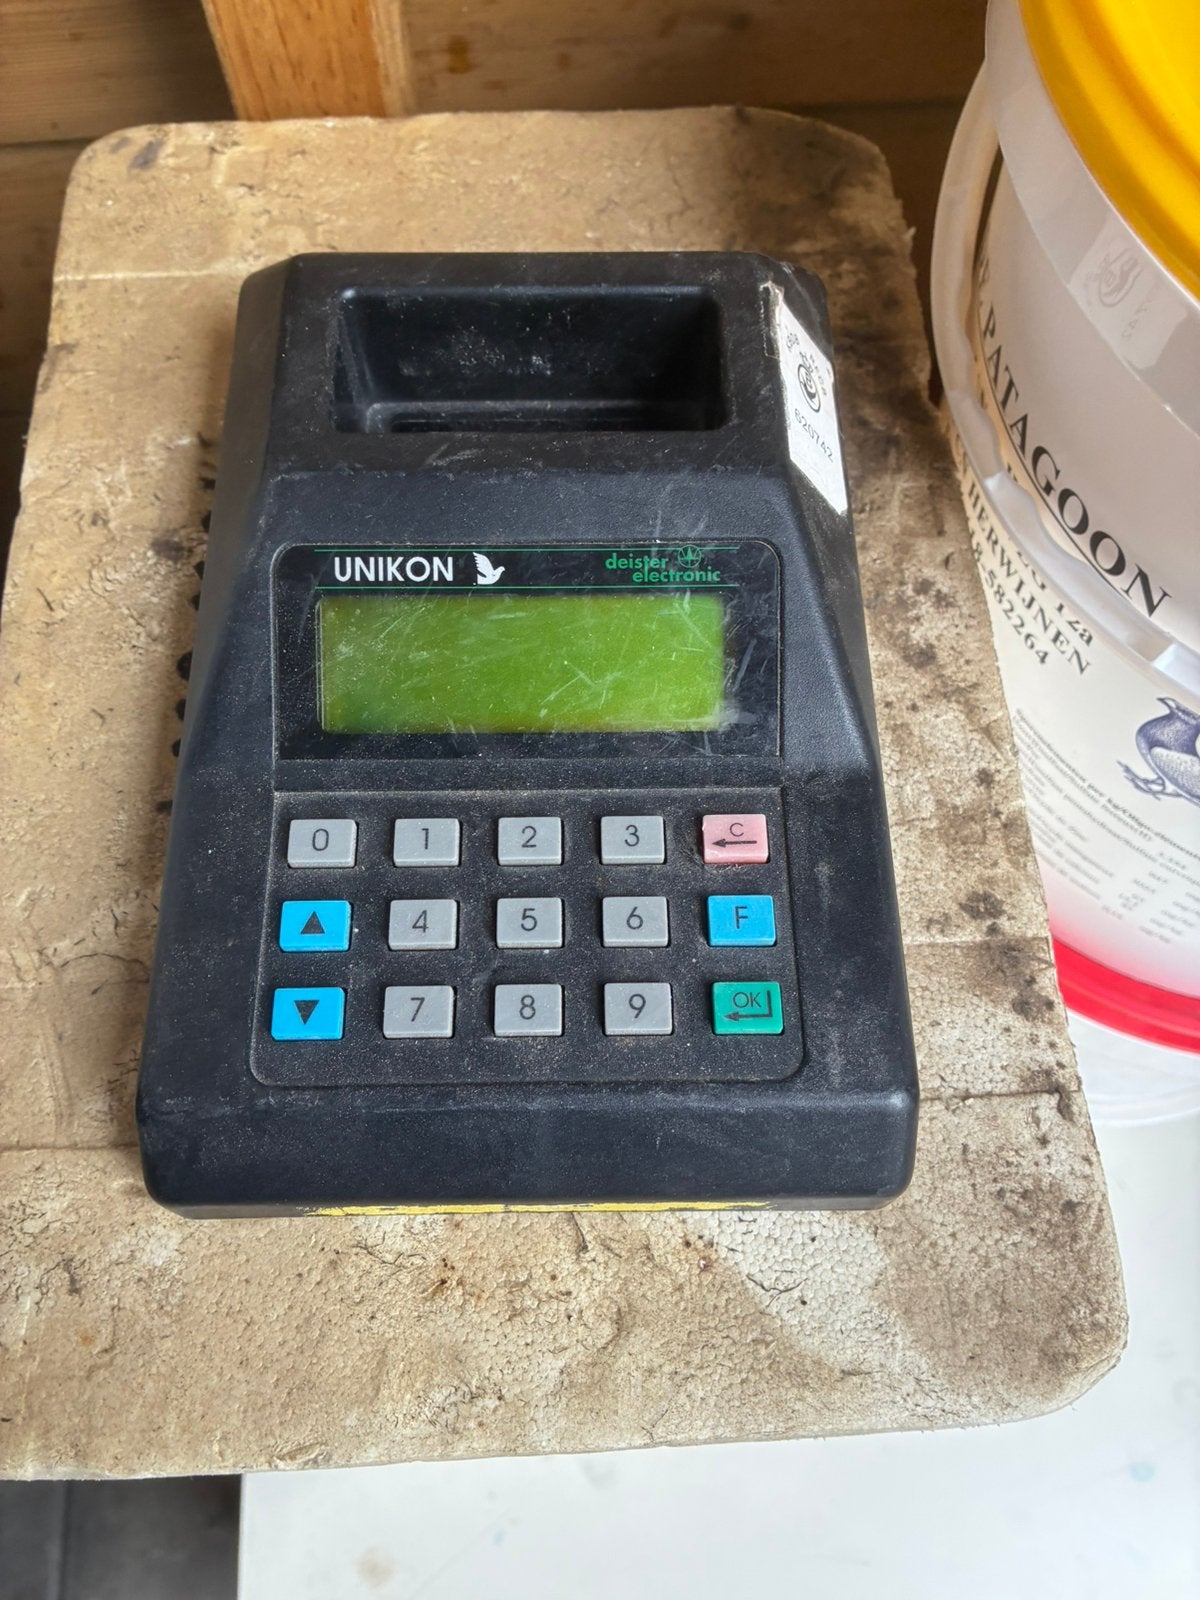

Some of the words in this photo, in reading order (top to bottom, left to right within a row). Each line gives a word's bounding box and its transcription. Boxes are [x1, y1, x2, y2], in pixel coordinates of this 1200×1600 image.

[983, 302, 1172, 618] PATAGOON
[334, 556, 454, 582] UNIKON
[605, 553, 668, 569] deister
[632, 566, 721, 582] electronic
[968, 482, 1091, 676] HERWIJNEN
[312, 829, 330, 851] 0
[421, 828, 430, 850] 1
[521, 826, 537, 848] 2
[625, 825, 640, 847] 3
[729, 822, 744, 837] C
[412, 910, 429, 933] 4
[520, 908, 538, 931] 5
[626, 906, 644, 930] 6
[735, 906, 748, 930] F
[410, 997, 425, 1022] 7
[519, 995, 536, 1020] 8
[628, 993, 646, 1018] 9
[733, 992, 761, 1008] OK
